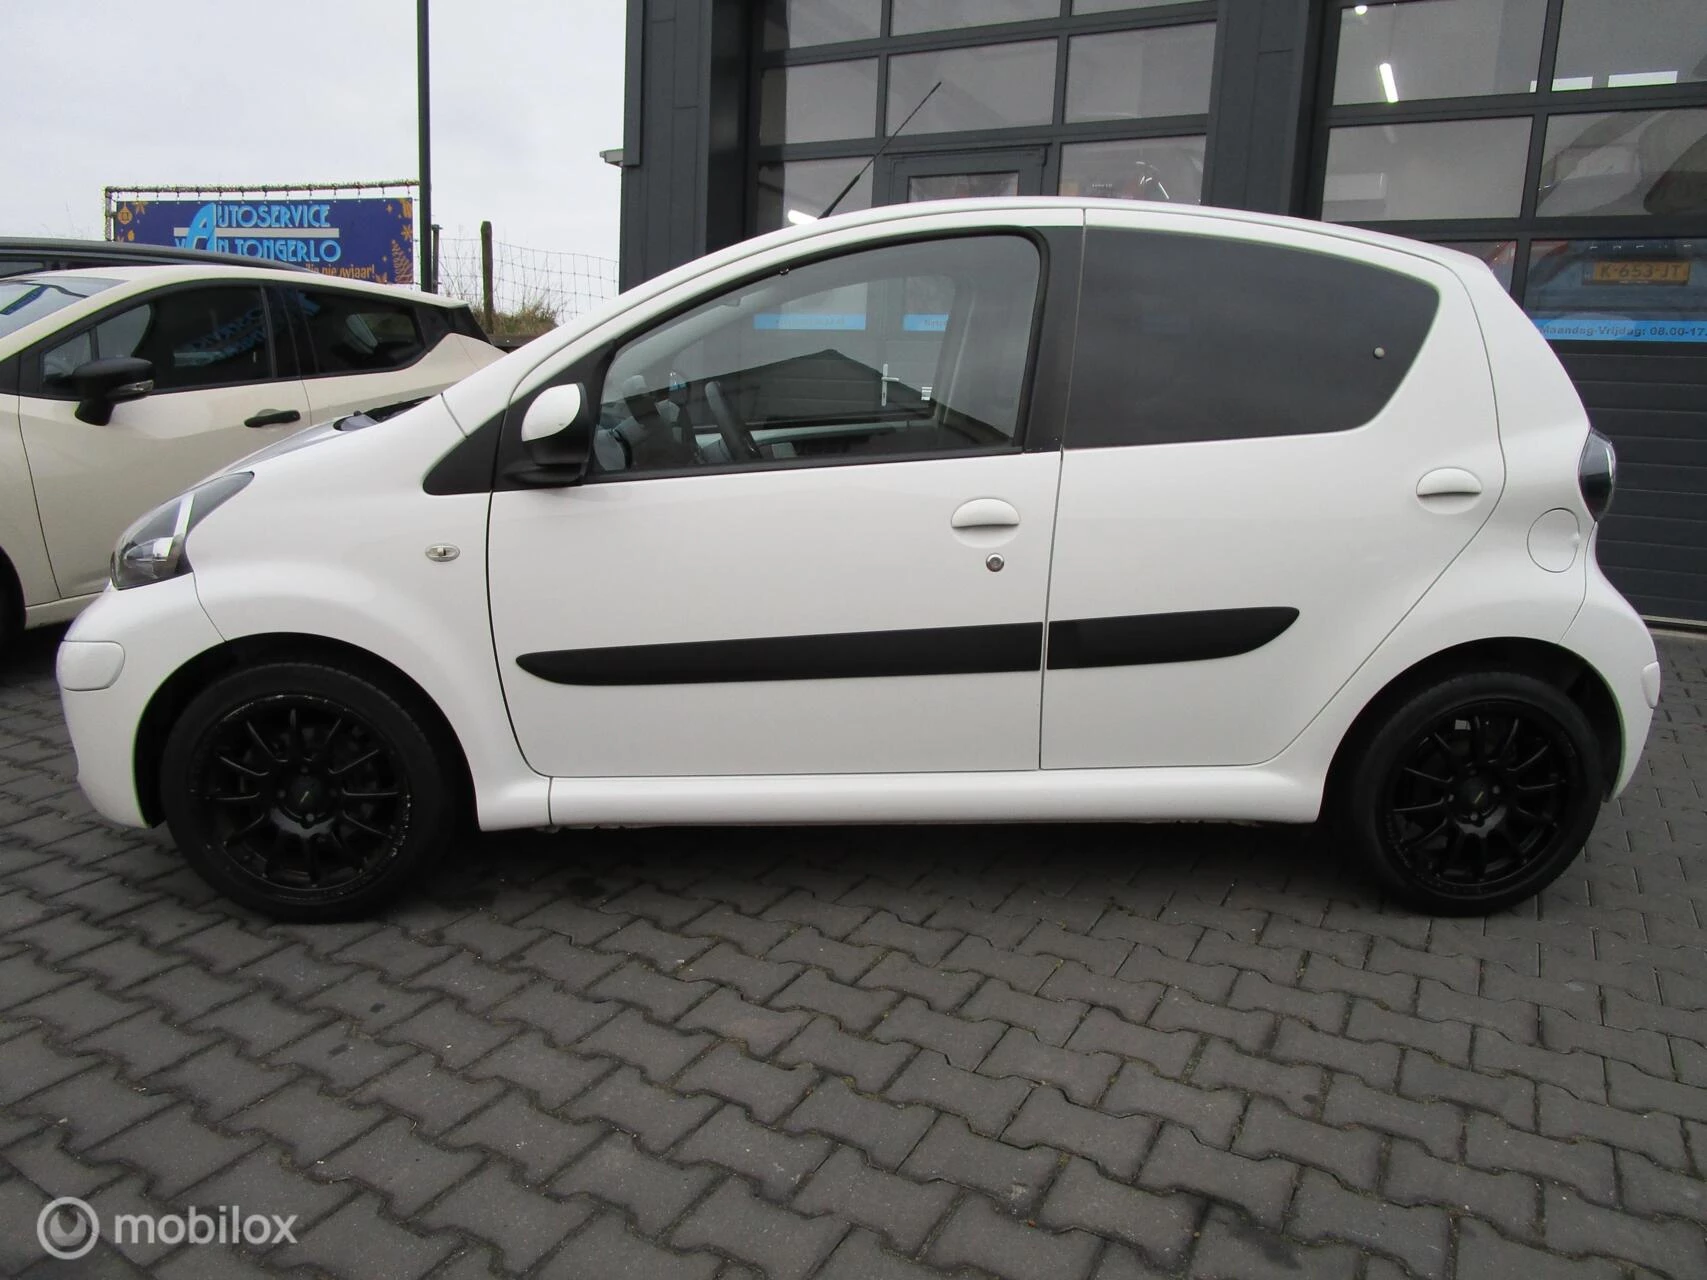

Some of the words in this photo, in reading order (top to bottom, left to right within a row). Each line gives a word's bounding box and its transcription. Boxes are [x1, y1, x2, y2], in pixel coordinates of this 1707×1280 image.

[186, 203, 331, 230] AUTOSERVICE
[235, 240, 342, 263] TONGERLO
[1600, 263, 1682, 278] K-653-JT
